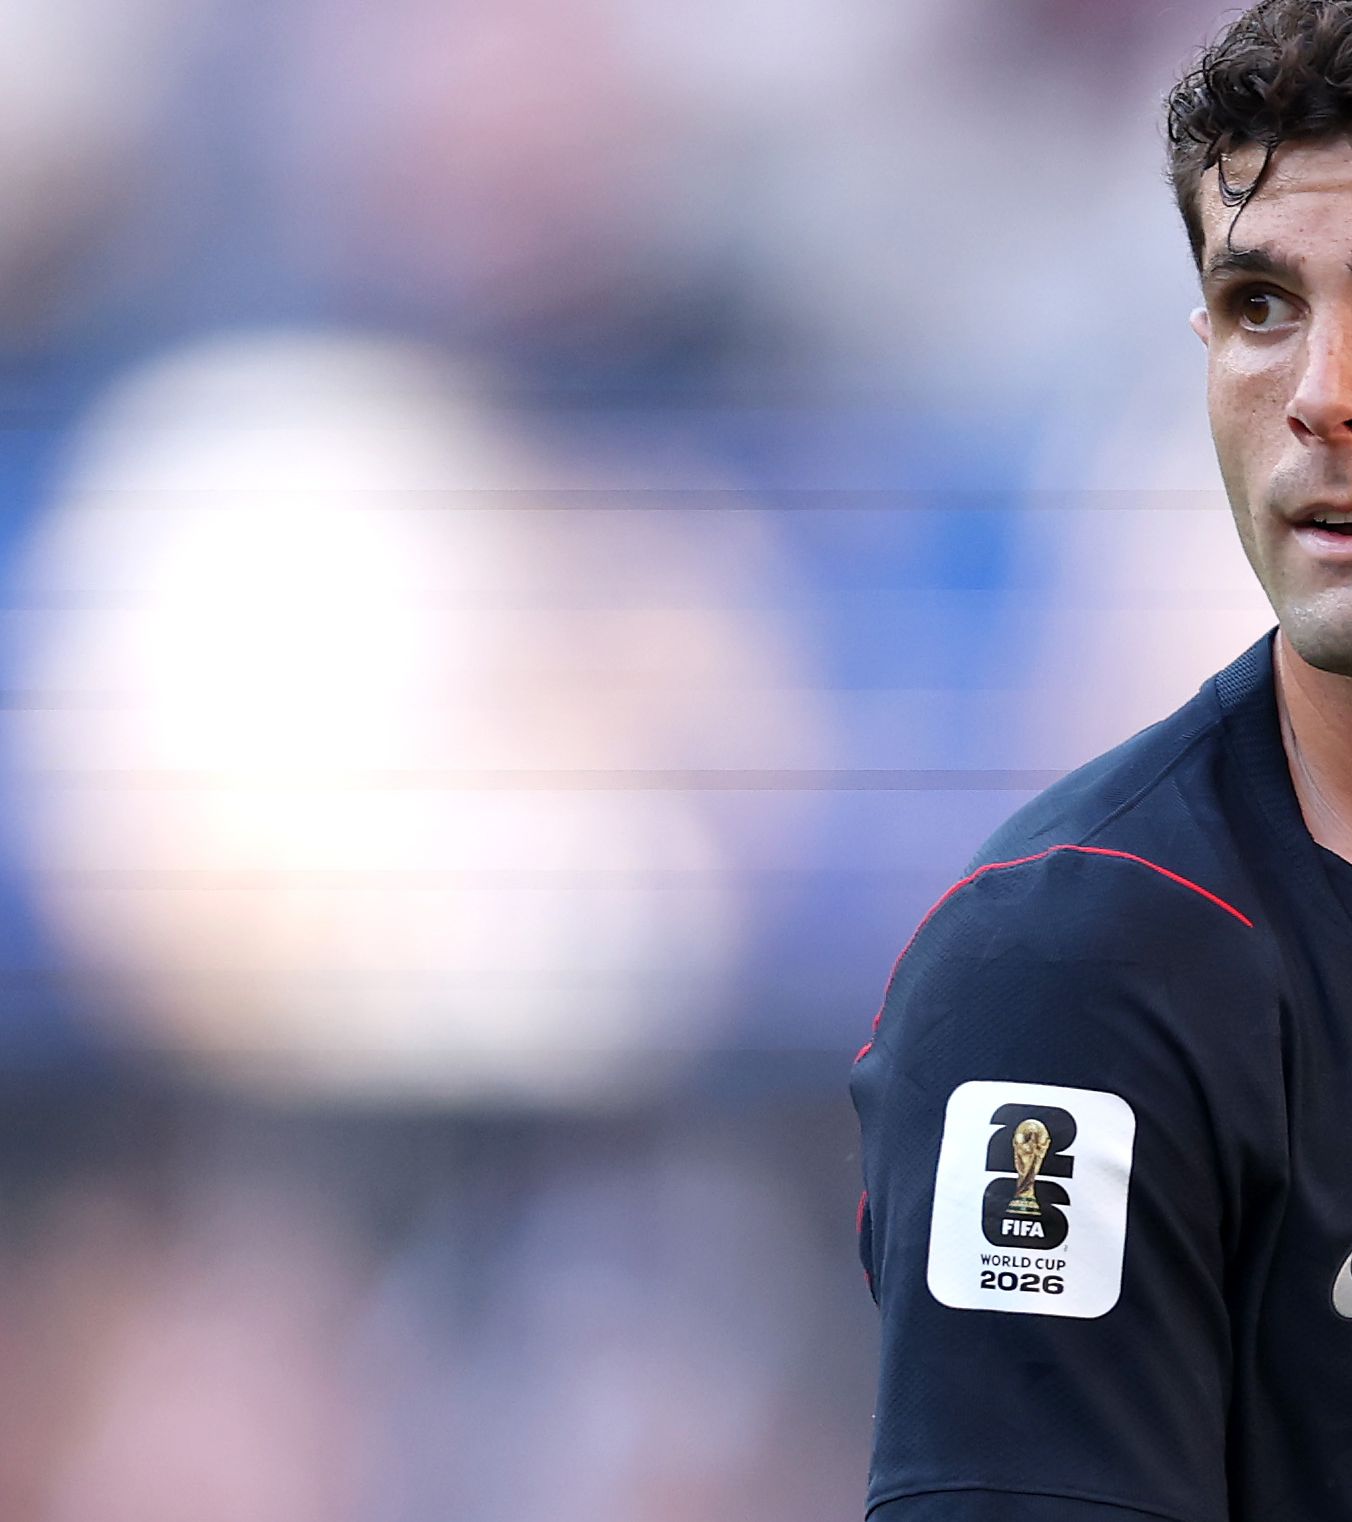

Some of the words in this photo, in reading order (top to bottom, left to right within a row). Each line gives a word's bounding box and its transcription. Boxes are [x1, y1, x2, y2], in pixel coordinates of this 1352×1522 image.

[1001, 1219, 1045, 1238] FIFA
[980, 1254, 1030, 1268] WORLD
[1035, 1257, 1066, 1271] CUP
[980, 1270, 1064, 1294] 2026
